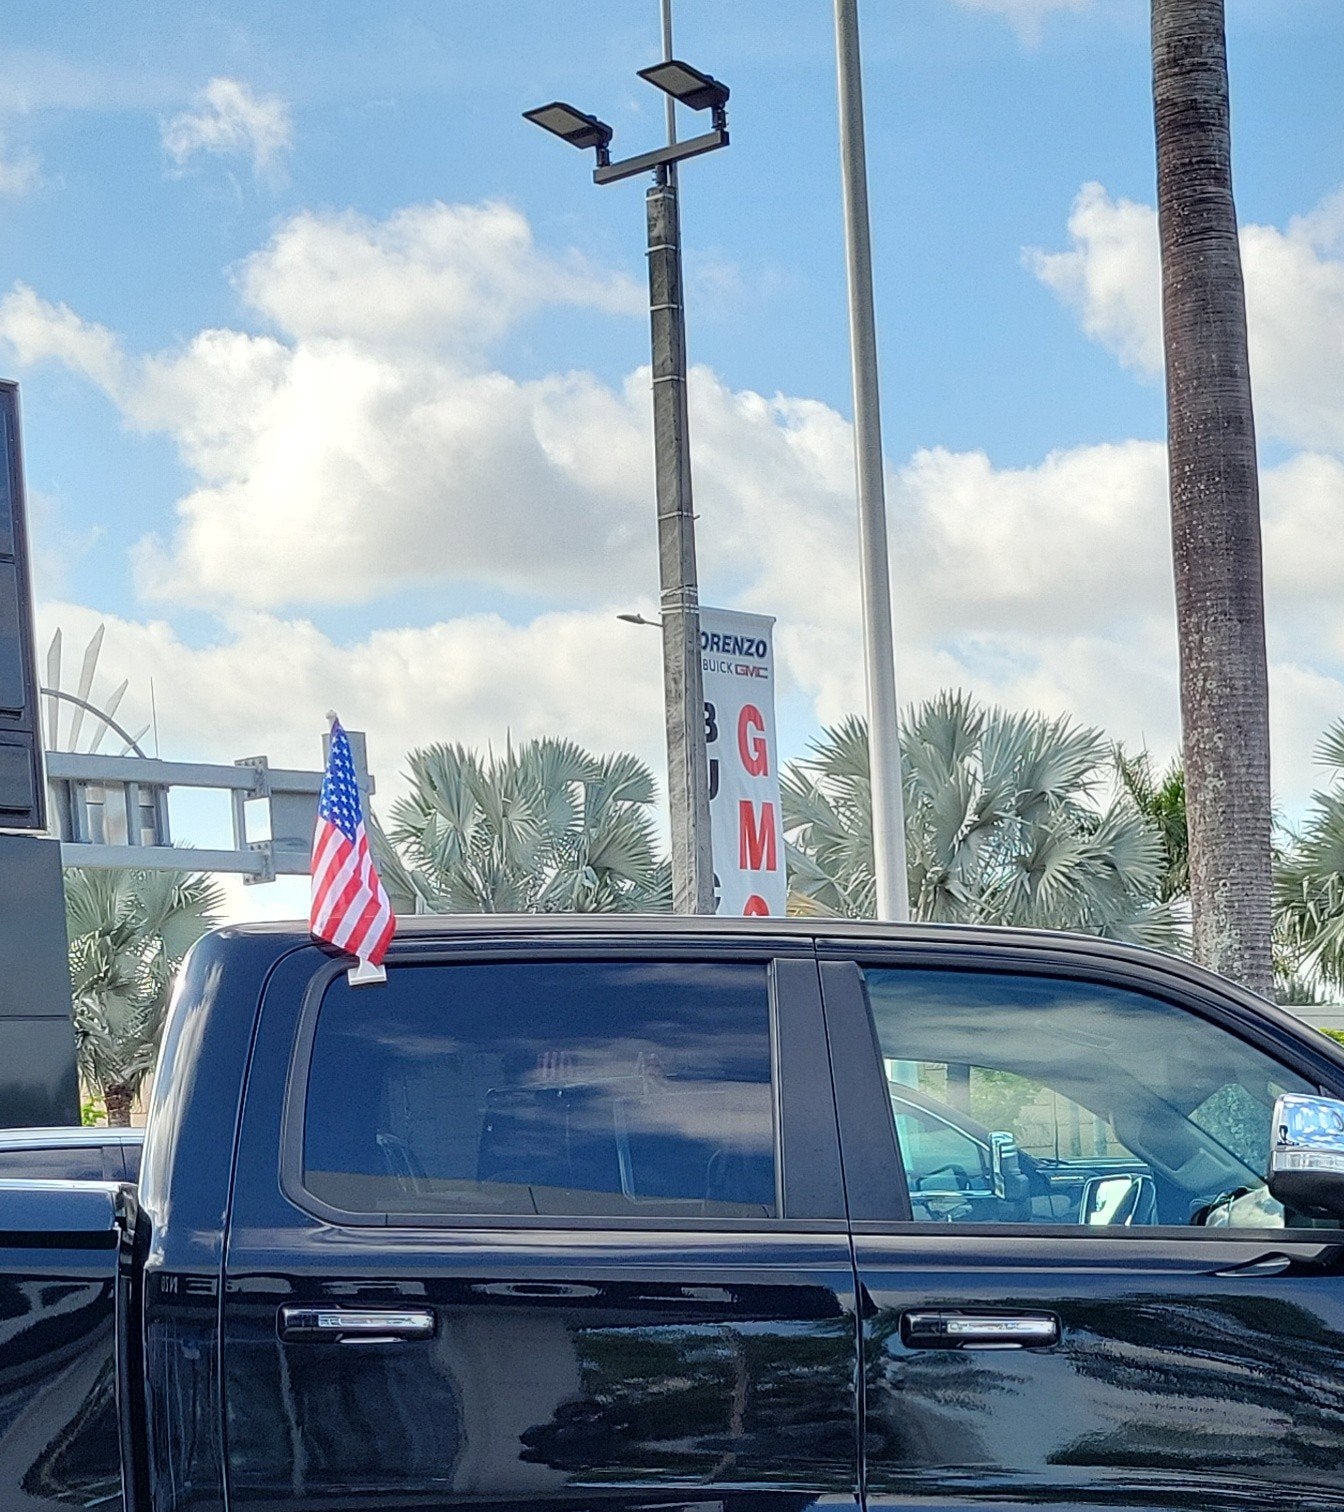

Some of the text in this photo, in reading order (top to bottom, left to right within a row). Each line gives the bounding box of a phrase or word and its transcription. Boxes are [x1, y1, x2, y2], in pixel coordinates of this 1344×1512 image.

[701, 631, 767, 658] ORENZO
[703, 659, 768, 679] BUICK GMC
[738, 704, 776, 916] GM
